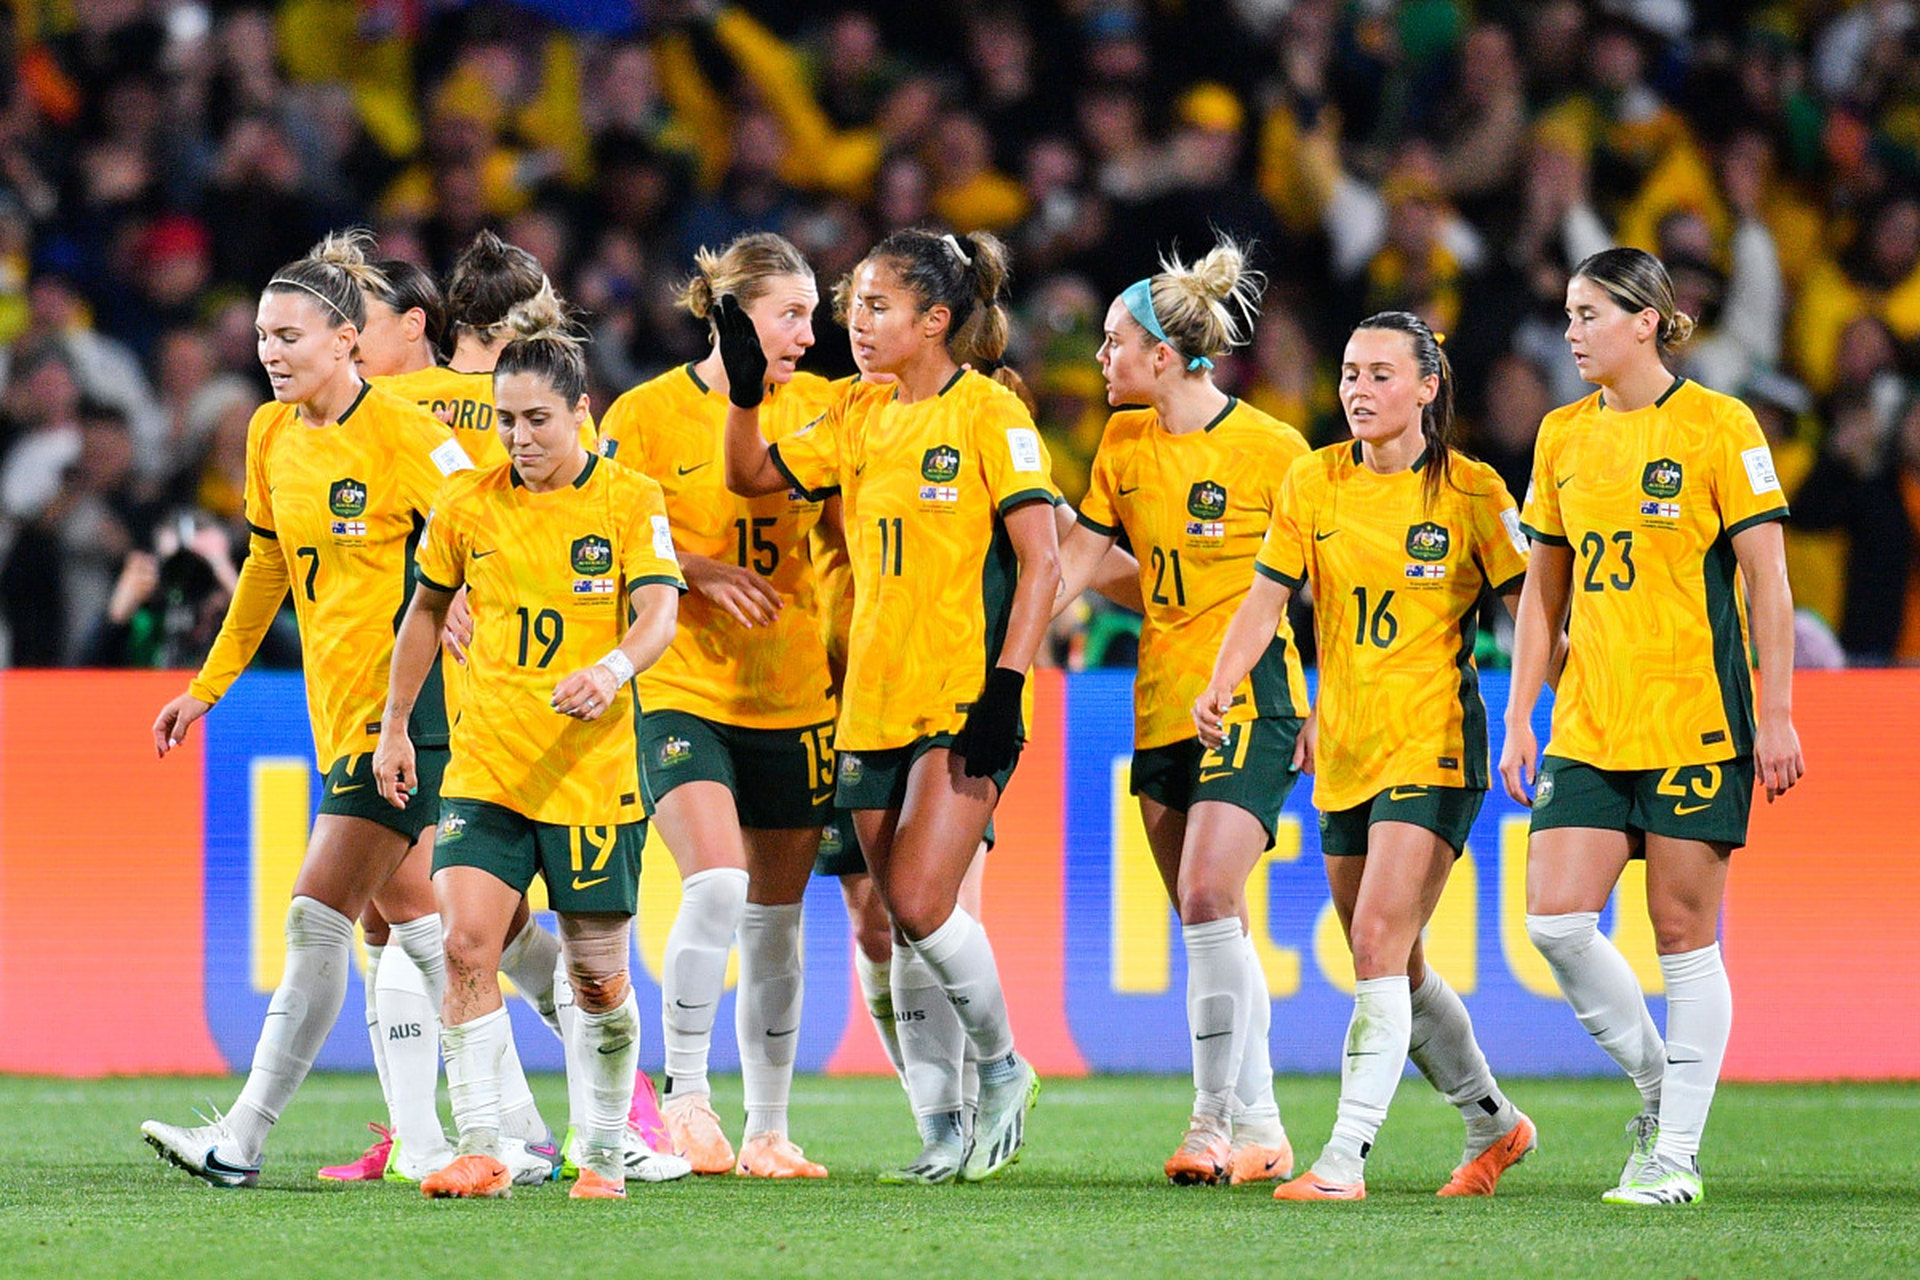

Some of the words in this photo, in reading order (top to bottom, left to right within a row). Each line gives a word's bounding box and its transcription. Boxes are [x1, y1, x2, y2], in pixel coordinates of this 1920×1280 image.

[418, 399, 493, 430] ORD
[296, 546, 320, 603] 7
[734, 517, 780, 577] 15
[878, 517, 903, 577] 11
[1151, 545, 1186, 607] 21
[1580, 531, 1636, 592] 23
[516, 606, 564, 669] 19
[1352, 586, 1398, 649] 16
[799, 724, 836, 790] 15
[569, 825, 617, 872] 19
[389, 1022, 422, 1041] AUS
